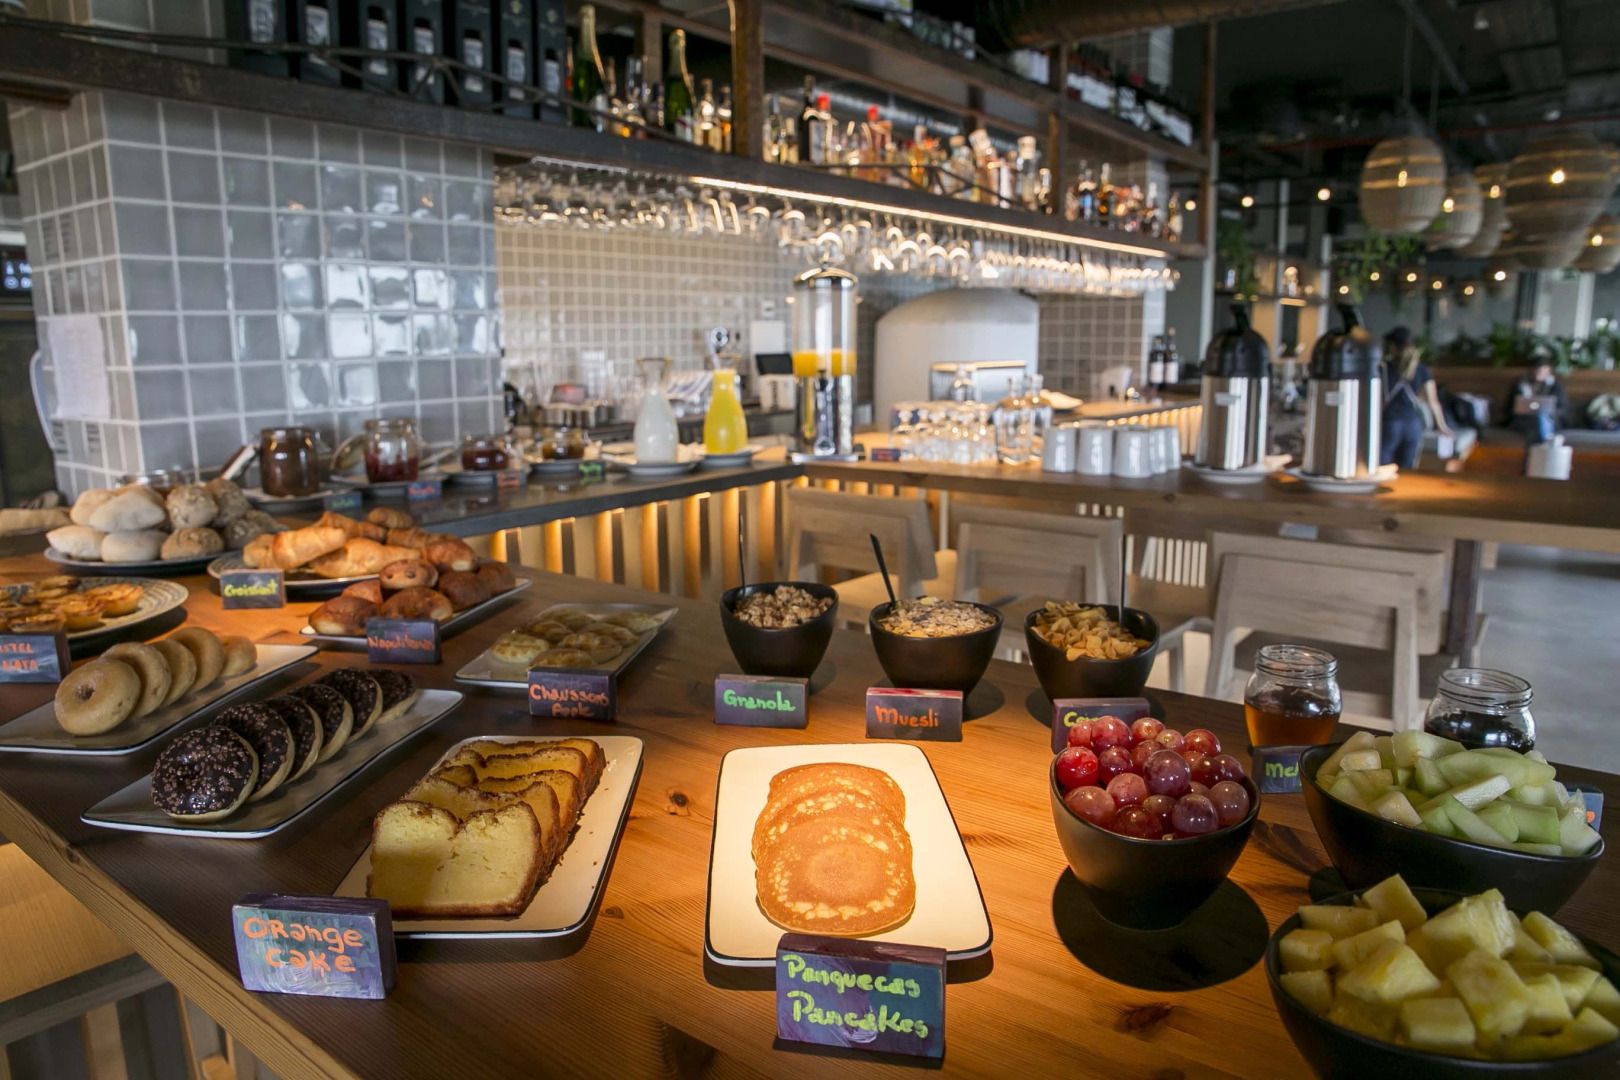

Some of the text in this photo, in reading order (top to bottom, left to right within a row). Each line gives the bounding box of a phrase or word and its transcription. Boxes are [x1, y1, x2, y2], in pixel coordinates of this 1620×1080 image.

[0, 642, 34, 654] STEL
[2, 658, 39, 671] NATA
[723, 689, 796, 711] Granola
[874, 705, 939, 727] Muesli
[782, 954, 920, 998] Panquecas
